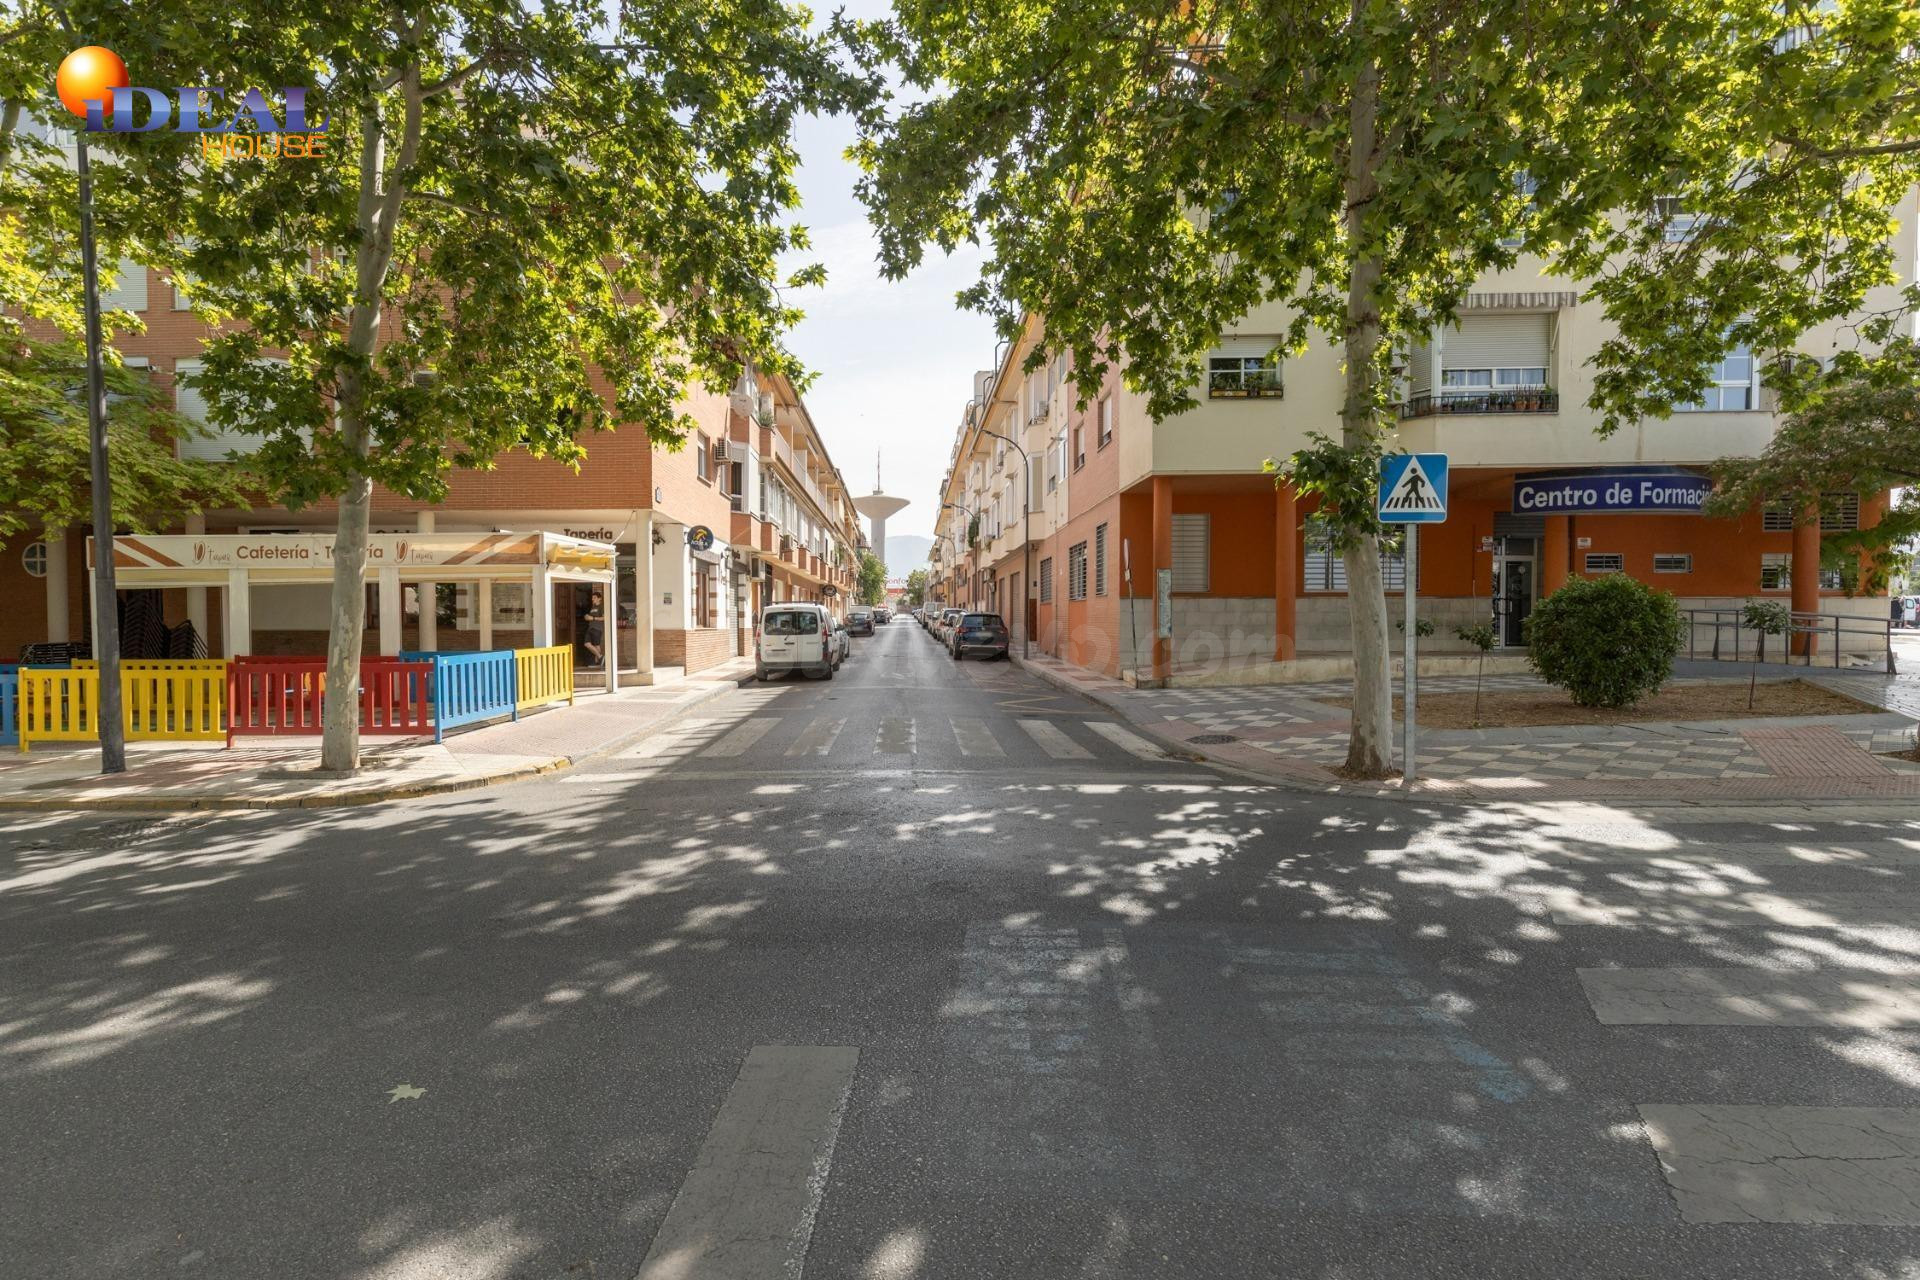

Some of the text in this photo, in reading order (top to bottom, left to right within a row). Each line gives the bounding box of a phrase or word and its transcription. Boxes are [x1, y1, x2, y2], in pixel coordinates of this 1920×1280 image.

[1519, 485, 1598, 509] Centro
[1605, 482, 1632, 504] de
[236, 544, 309, 559] Cafetería
